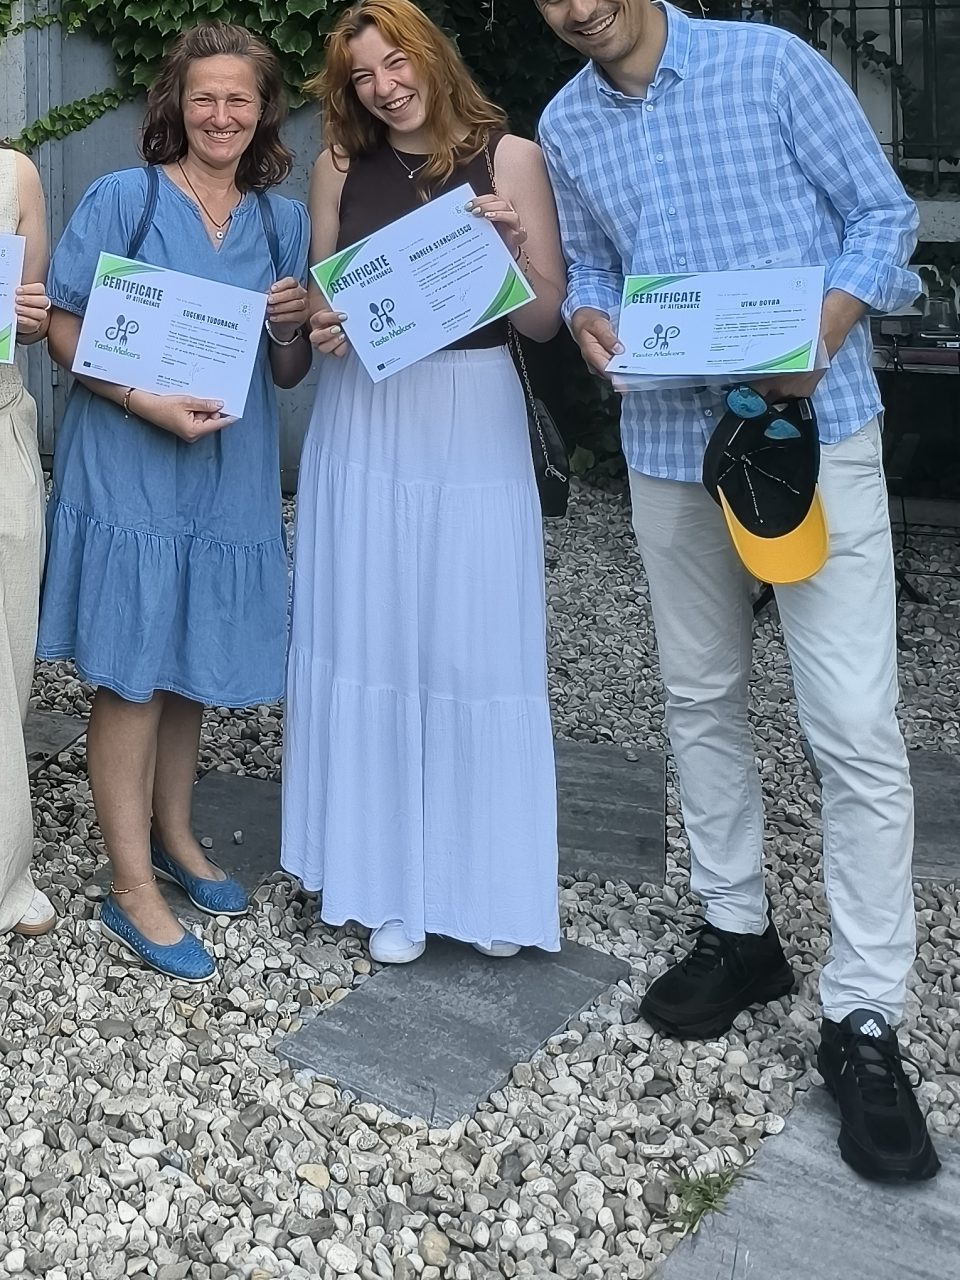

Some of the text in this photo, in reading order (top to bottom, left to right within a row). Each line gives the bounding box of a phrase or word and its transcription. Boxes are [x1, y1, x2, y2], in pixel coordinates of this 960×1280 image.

[408, 244, 434, 262] ANDREEA
[433, 224, 472, 249] STANCIULESCU
[330, 254, 390, 294] CERTIFICATE
[366, 267, 394, 286] ATTENDANCE
[102, 275, 164, 302] CERTIFICATE
[631, 291, 702, 304] CERTIFICATE
[132, 296, 161, 309] ATTENDANCE
[182, 309, 239, 331] EUGENIA TUDORACHE
[369, 320, 417, 349] Taste Makers
[94, 340, 141, 360] Taste Makers
